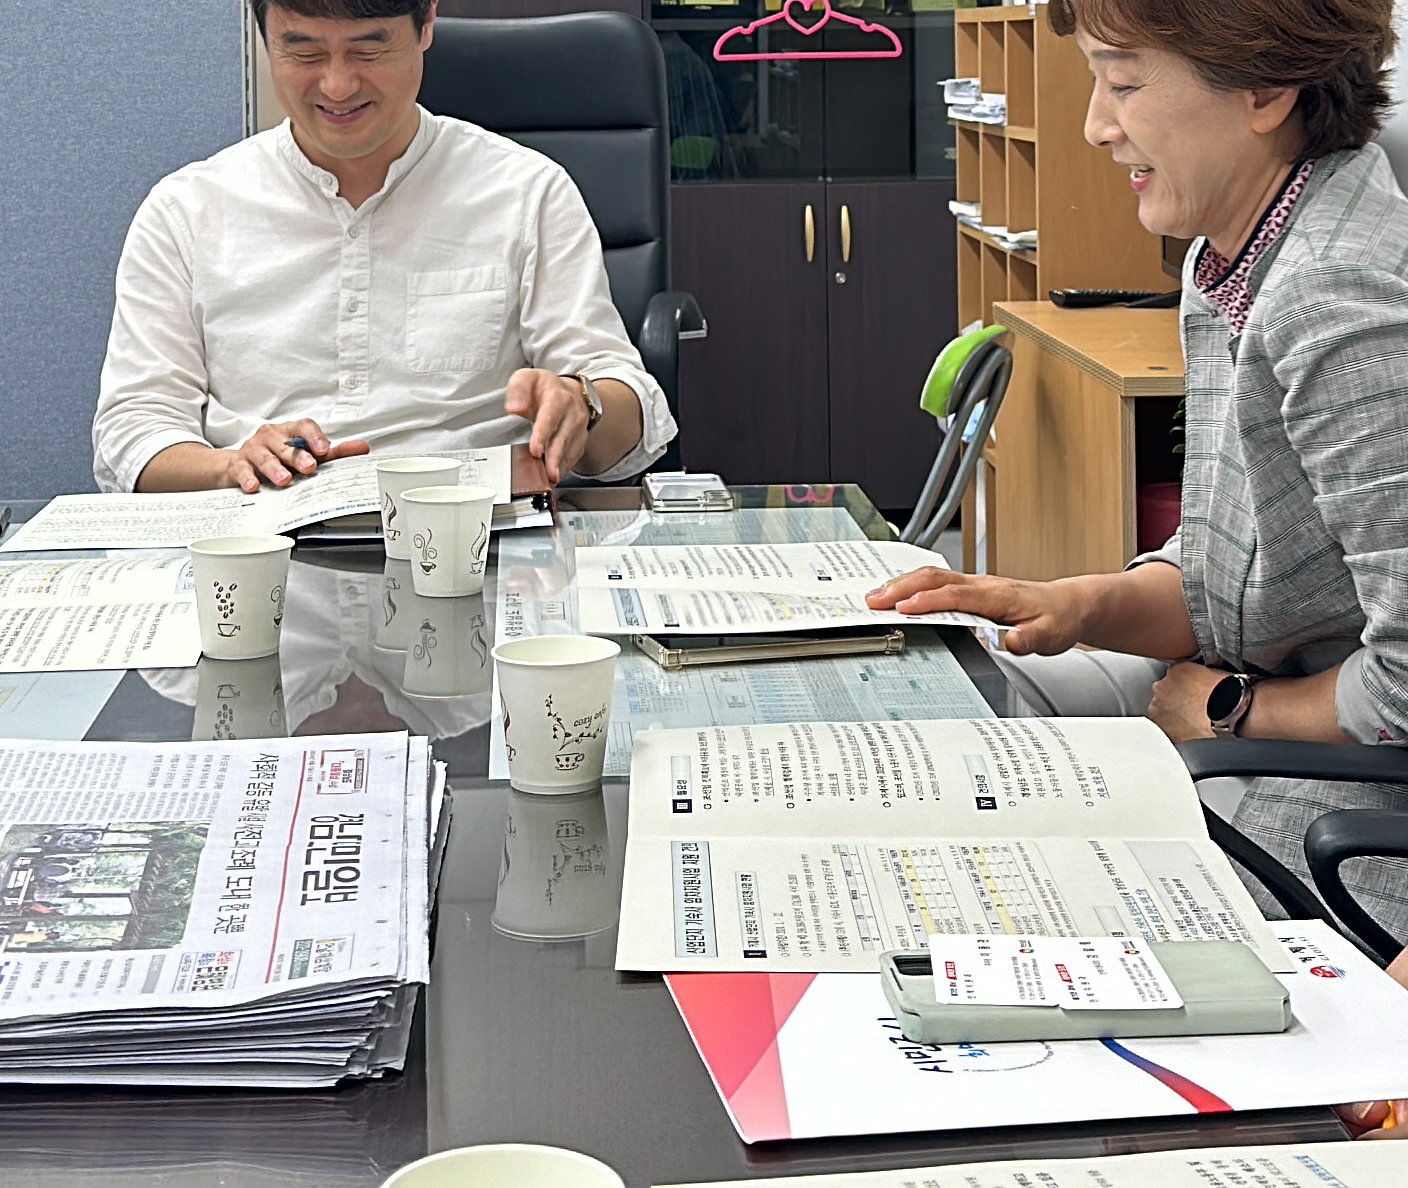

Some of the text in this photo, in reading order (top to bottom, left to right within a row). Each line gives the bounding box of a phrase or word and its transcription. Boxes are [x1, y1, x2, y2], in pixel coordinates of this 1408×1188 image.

[574, 715, 593, 728] cozy
[249, 753, 279, 779] 사회적
[246, 782, 274, 797] 갈등
[676, 779, 688, 796] 필요성
[242, 799, 271, 812] 유발
[681, 854, 699, 865] 지원
[220, 876, 253, 900] 도내
[682, 868, 702, 903] 임차지원사업
[218, 903, 250, 912] 한
[743, 907, 756, 919] 기숙사
[684, 906, 703, 925] 기숙사
[213, 914, 247, 934] 곳뿐
[745, 920, 758, 935] 산업단지
[685, 929, 706, 954] 산업단지
[747, 937, 759, 948] 거제시
